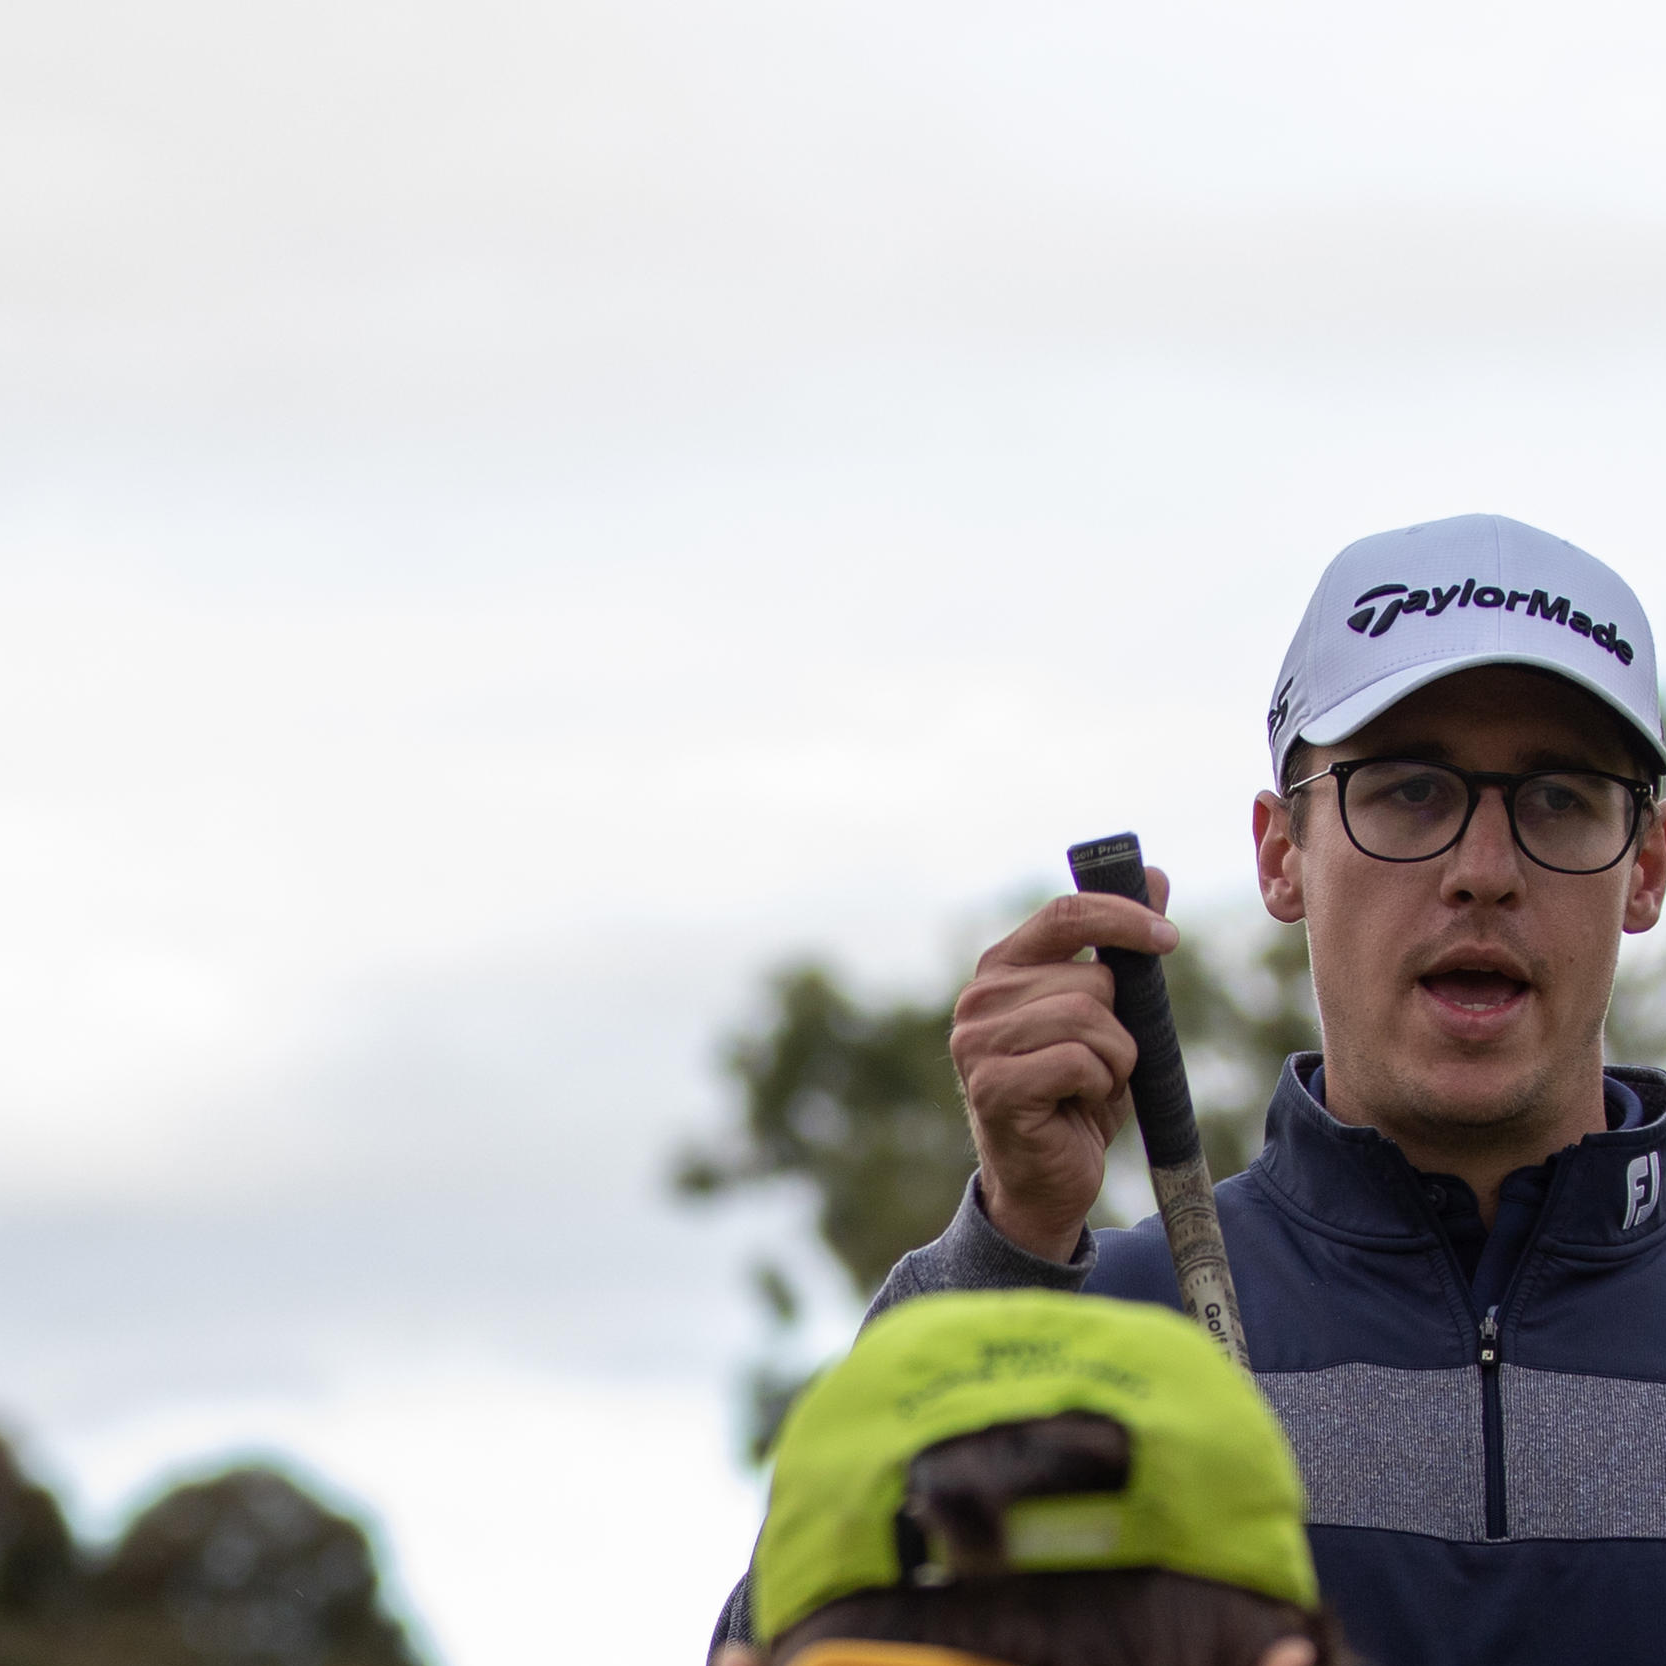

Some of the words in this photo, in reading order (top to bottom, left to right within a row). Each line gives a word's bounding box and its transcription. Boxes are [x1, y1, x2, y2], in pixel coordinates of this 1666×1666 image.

[1346, 578, 1634, 666] TaylorMade
[1622, 1151, 1660, 1230] FJ
[1205, 1303, 1228, 1345] Golf
